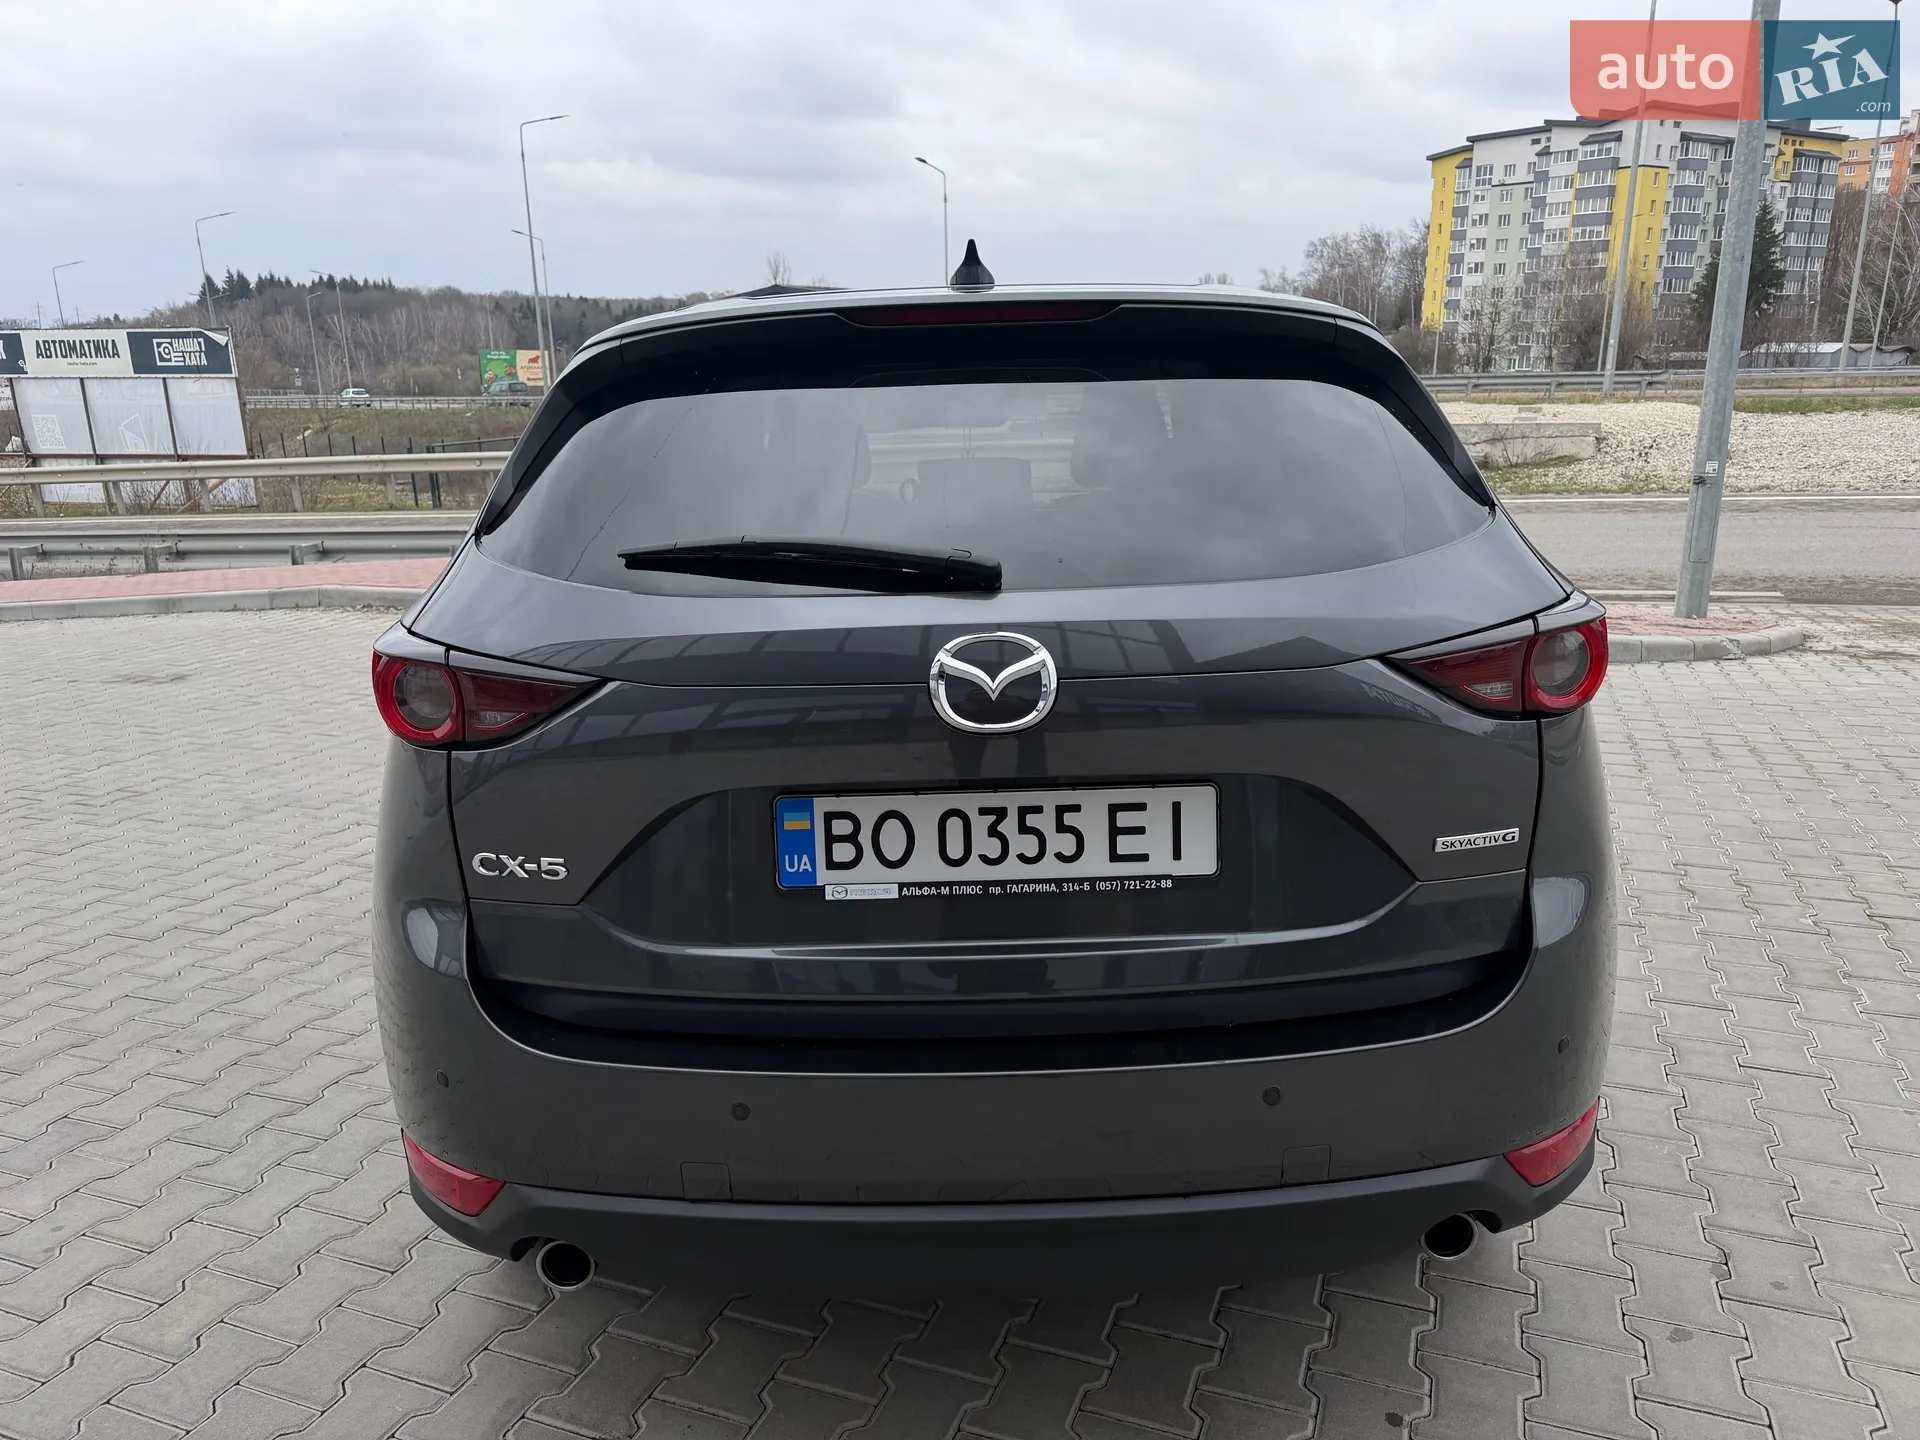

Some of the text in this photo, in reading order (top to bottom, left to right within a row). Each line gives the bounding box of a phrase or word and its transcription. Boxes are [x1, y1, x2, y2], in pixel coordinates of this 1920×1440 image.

[35, 339, 121, 359] АВТОМАТИКА
[183, 352, 208, 366] ХАТА
[823, 801, 1183, 871] BO 0355 EI
[471, 852, 568, 881] CX-5
[785, 854, 812, 873] UA
[901, 879, 1173, 897] АЛЬФА-М ПЛЮС пр. ГАГАРИНА, 314-Б (057) 721-22-88
